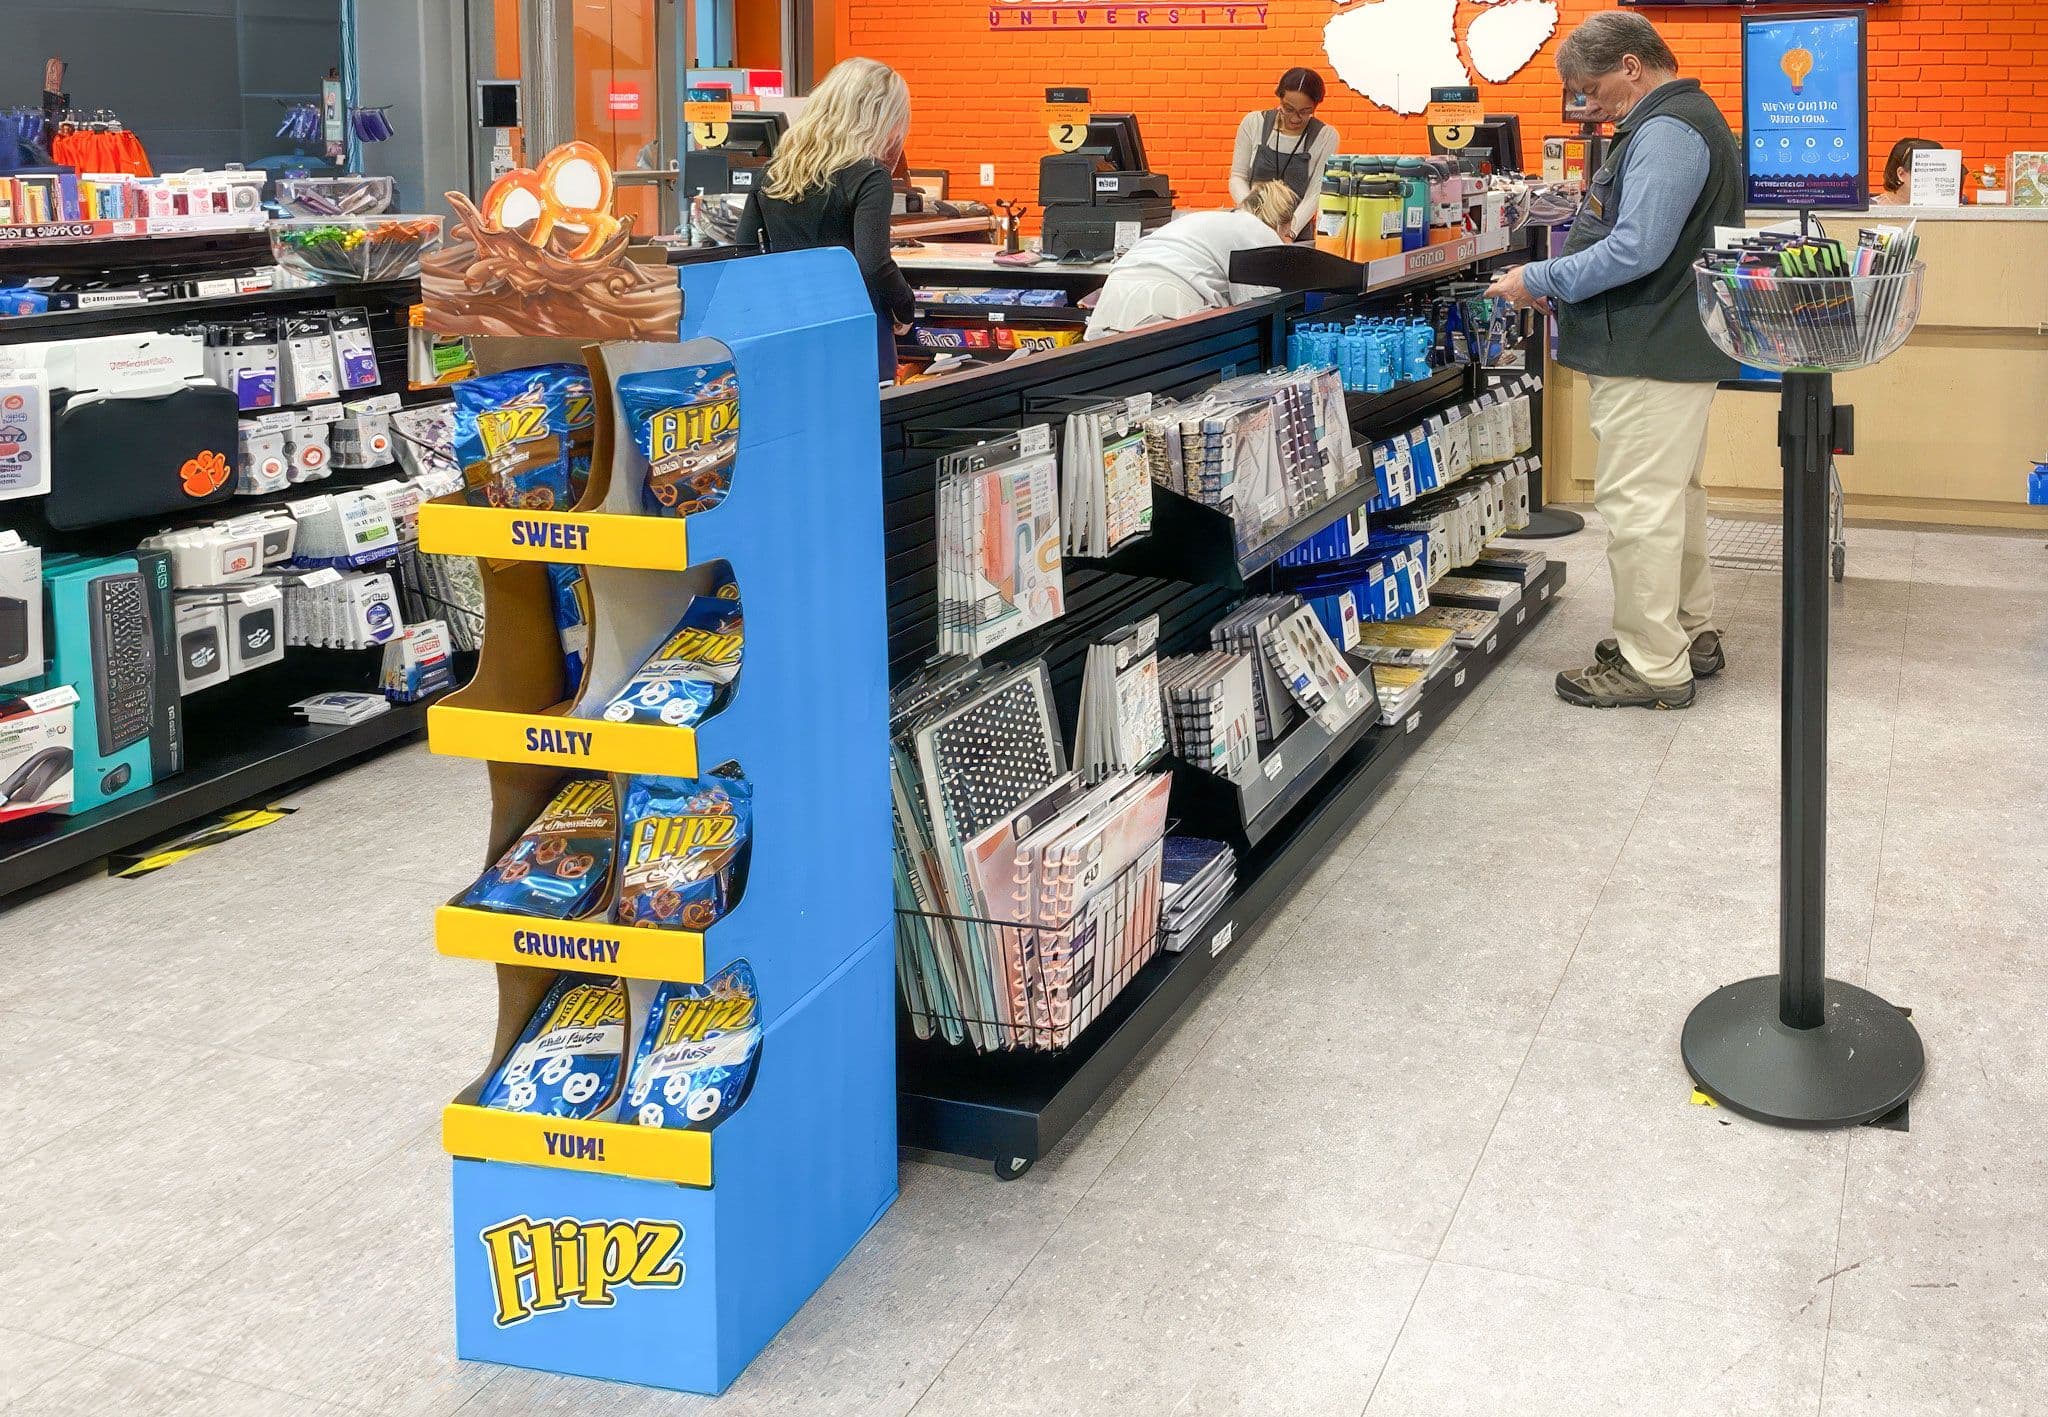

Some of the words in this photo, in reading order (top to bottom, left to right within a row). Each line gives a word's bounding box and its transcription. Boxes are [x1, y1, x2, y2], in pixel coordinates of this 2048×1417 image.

[703, 122, 716, 140] 1
[1059, 124, 1073, 144] 2
[1446, 125, 1460, 141] 3
[511, 520, 590, 551] SWEET
[525, 727, 593, 756] SALTY
[622, 815, 738, 873] Flipz
[513, 930, 621, 964] CRUNCHY
[543, 1131, 606, 1162] YUM!
[480, 1214, 685, 1328] Flipz
